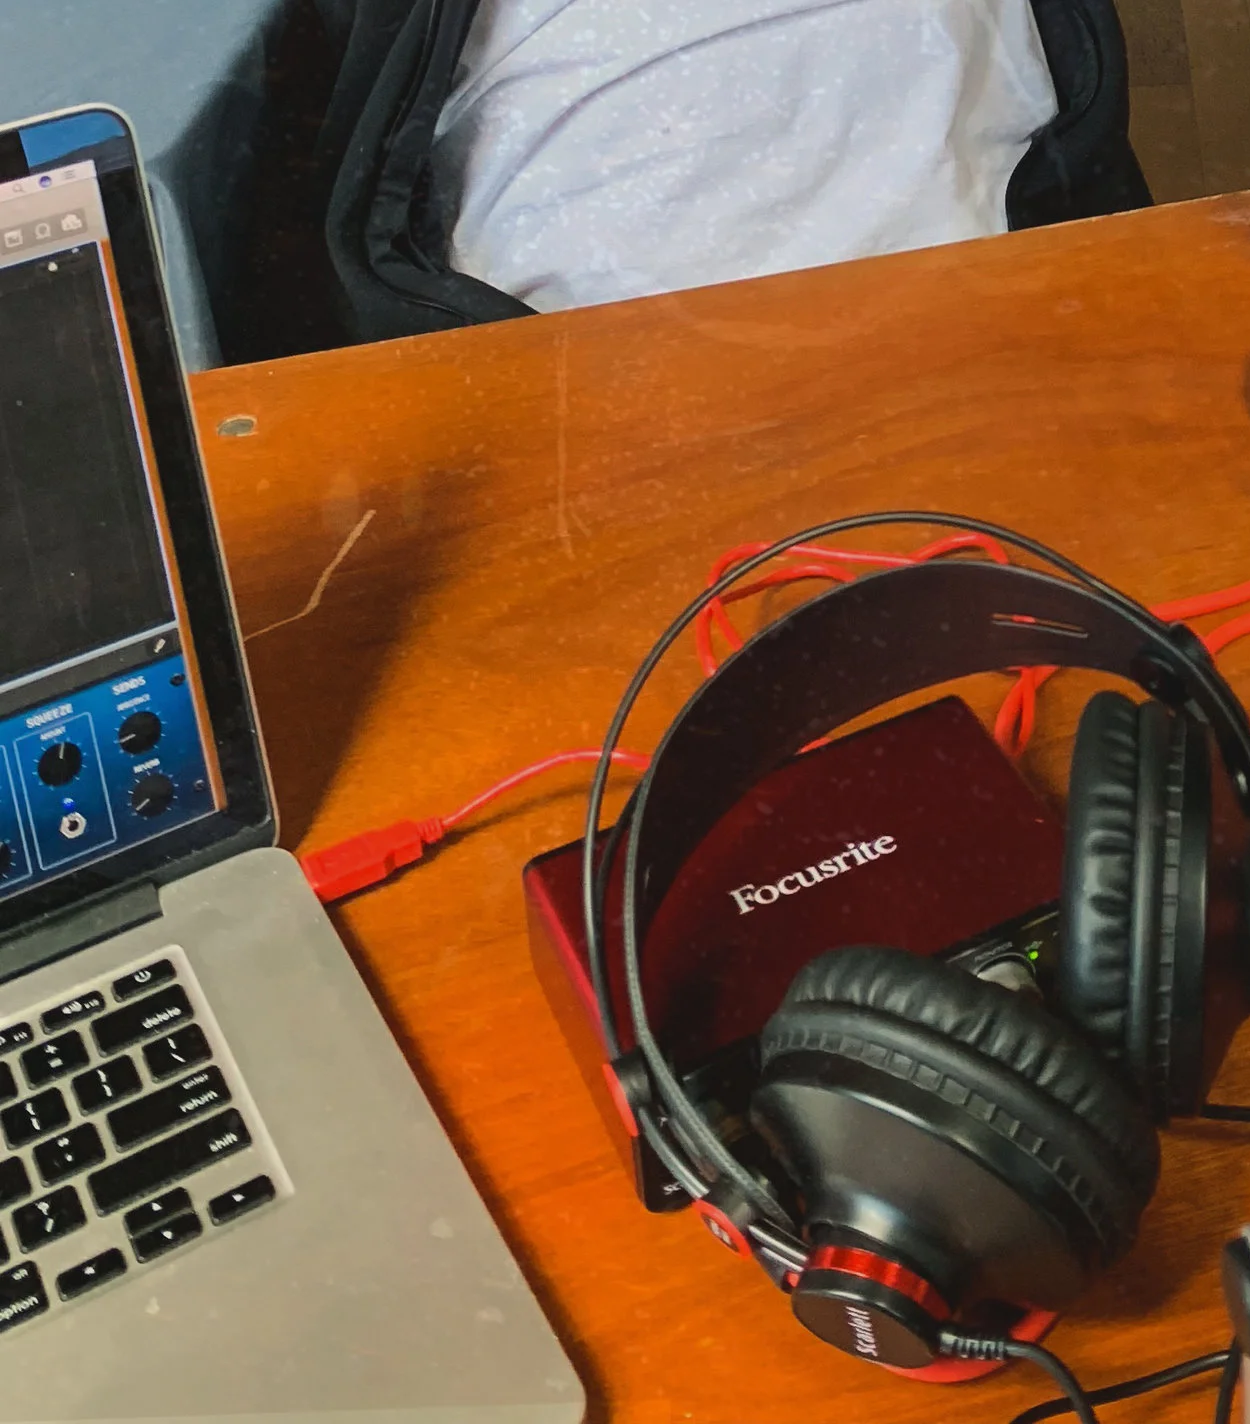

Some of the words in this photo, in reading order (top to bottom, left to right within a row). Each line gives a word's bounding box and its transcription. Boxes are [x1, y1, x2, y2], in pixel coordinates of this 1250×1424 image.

[112, 676, 146, 695] SENDS
[26, 703, 74, 728] SQUEEZE
[729, 835, 897, 915] Focusrite
[142, 1006, 182, 1029] delete
[179, 1089, 219, 1113] return
[208, 1131, 239, 1153] shift
[845, 1305, 879, 1357] Scarlett
